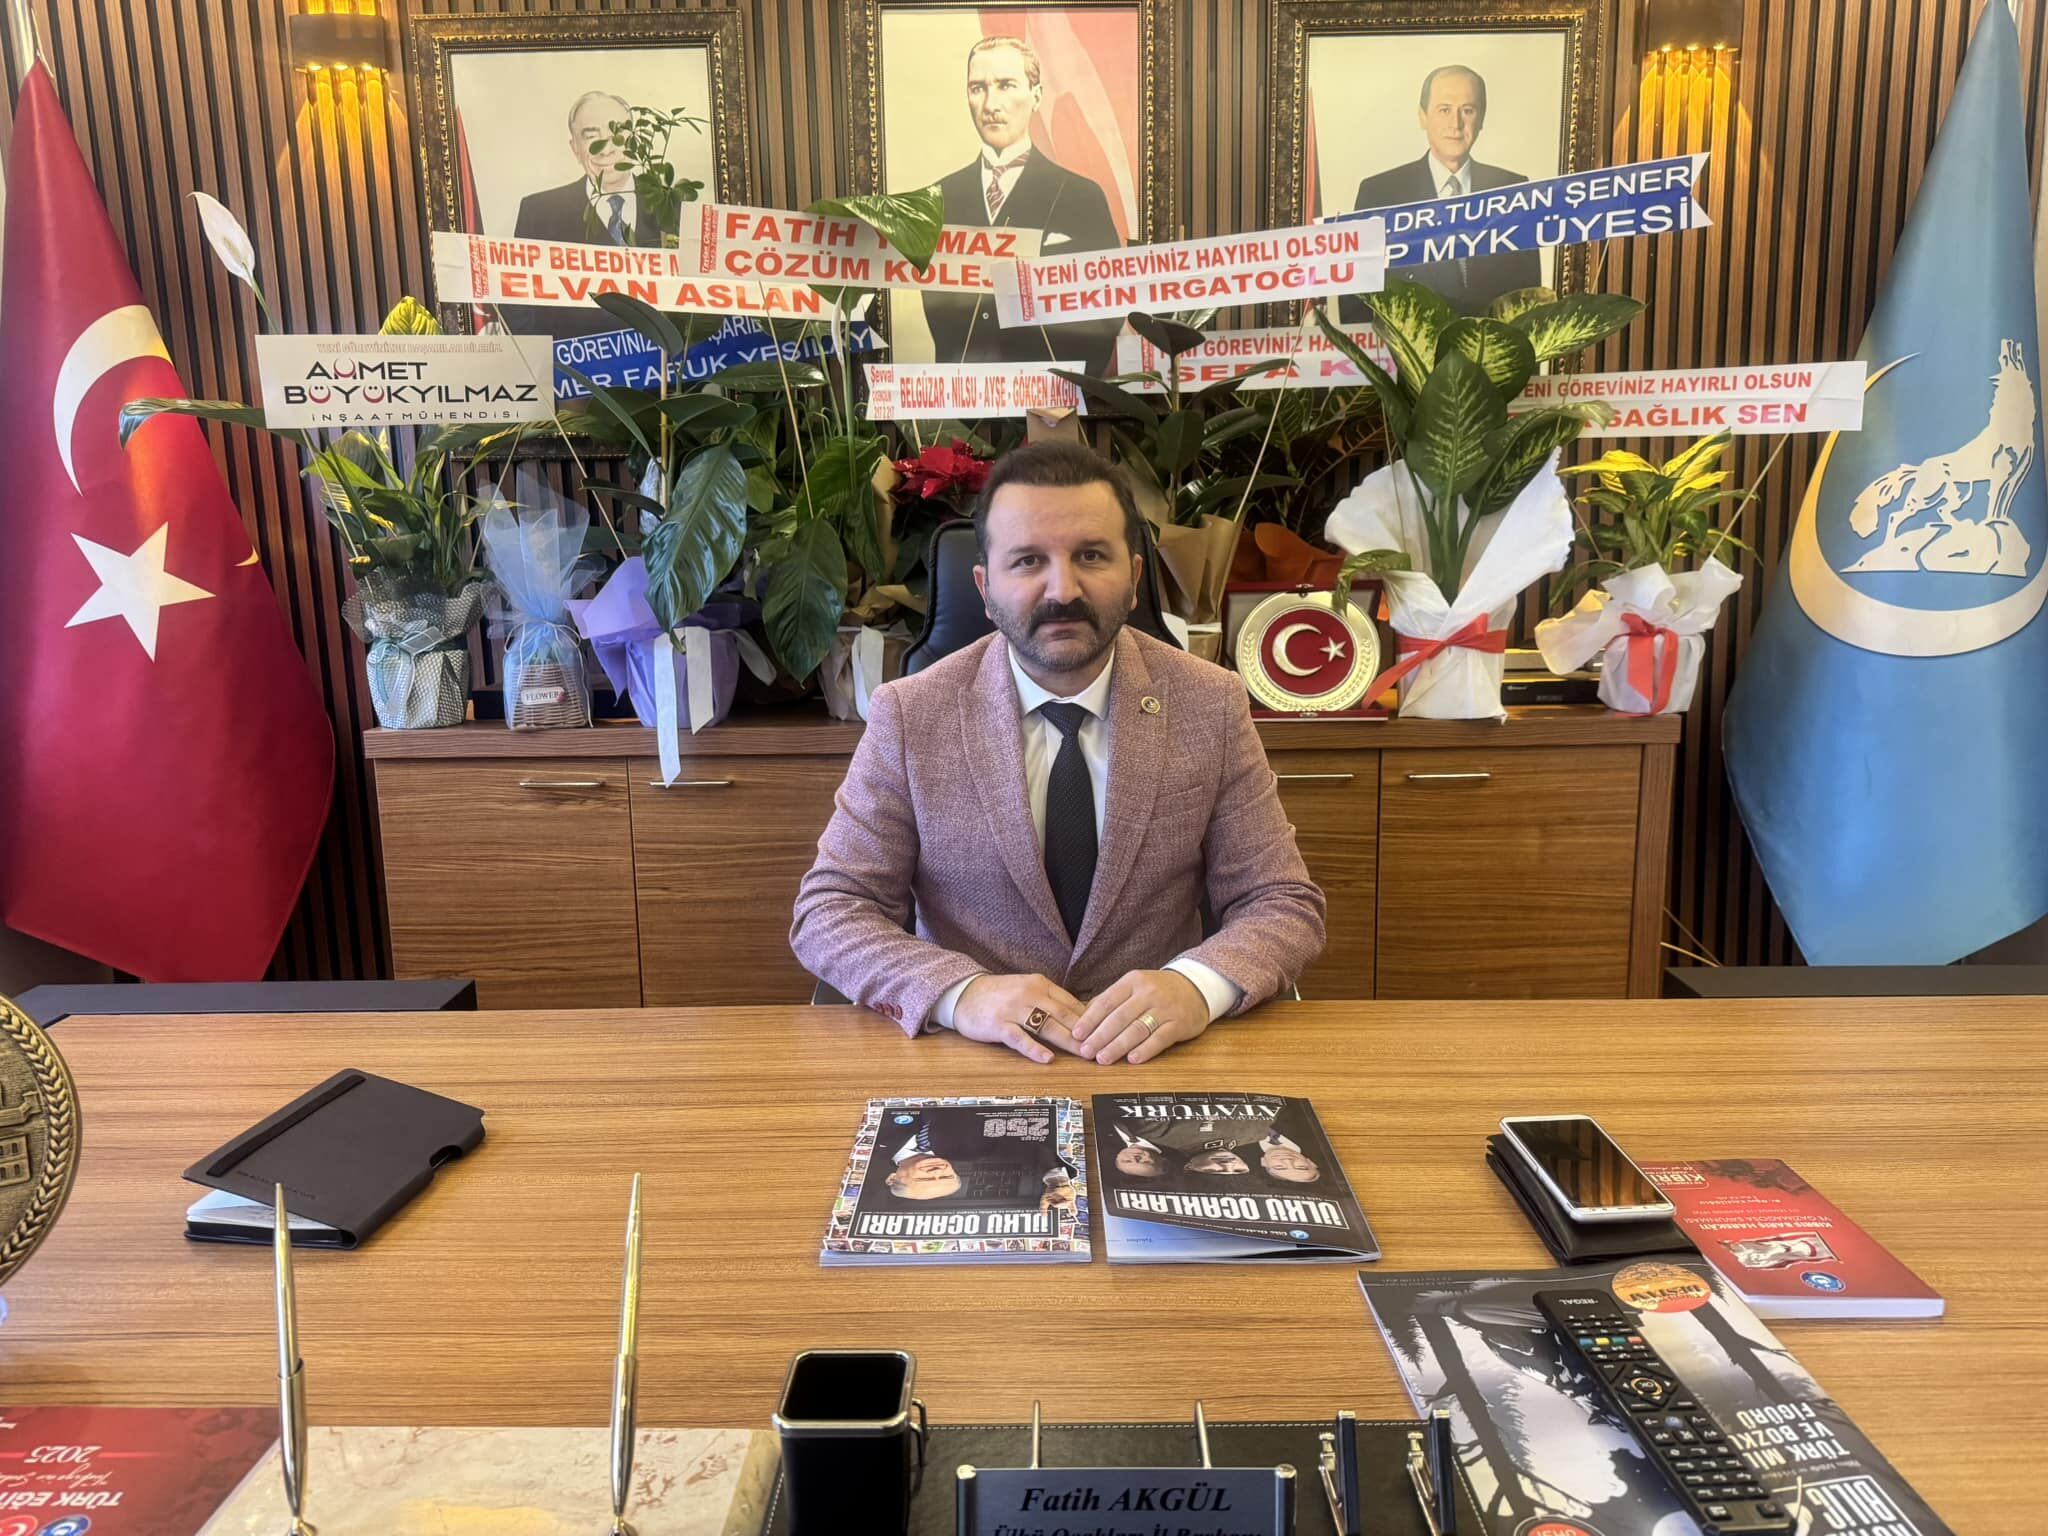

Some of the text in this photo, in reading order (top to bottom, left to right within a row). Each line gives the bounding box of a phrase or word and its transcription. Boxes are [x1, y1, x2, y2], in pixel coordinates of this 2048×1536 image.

[1564, 166, 1692, 209] ŞENER
[725, 213, 858, 249] FATİH
[1422, 225, 1520, 264] MYK
[1536, 196, 1693, 248] ÜYESİ
[489, 241, 541, 268] MHP
[549, 247, 663, 277] BELEDİYE
[724, 247, 870, 282] ÇÖZÜM
[1033, 231, 1360, 288] YENİ GÖREVİNİZ HAYIRLI OLSUN
[500, 271, 822, 314] ELVAN ASLAN
[1037, 283, 1137, 314] TEKİN
[1150, 262, 1356, 302] IRGATOĞLU
[1204, 333, 1303, 357] GÖREVİNİZ
[306, 358, 428, 380] AHMET
[623, 353, 728, 388] FARUK
[284, 384, 539, 405] BÜYÜKYILMAZ
[900, 370, 945, 409] BELGÜZAR
[951, 368, 978, 409] NİLSU
[983, 376, 1007, 416] AYŞE
[1558, 375, 1655, 398] GÖREVİNİZ
[1661, 373, 1738, 394] HAYIRLI
[1745, 371, 1812, 390] OLSUN
[311, 411, 520, 423] İNŞAAT MÜHENDİSİ
[1610, 403, 1727, 428] SAĞLIK
[1737, 403, 1809, 425] SEN
[1120, 1104, 1282, 1121] ATATÜRK
[983, 1117, 1050, 1138] 250
[1650, 1174, 1706, 1183] KIBRI
[1120, 1192, 1260, 1220] OCAKLARI
[1264, 1198, 1343, 1226] ÜLKÜ
[860, 1213, 1050, 1236] ÜLKÜ OCAKLARI
[1737, 1402, 1816, 1429] FİGÜRÜ
[1799, 1420, 1835, 1439] VE
[23, 1445, 102, 1464] 2025
[1785, 1438, 1850, 1462] TÜRK
[50, 1491, 124, 1511] TÜRK
[1020, 1483, 1233, 1512] Fatih AKGÜL
[1804, 1479, 1897, 1530] BİLİG
